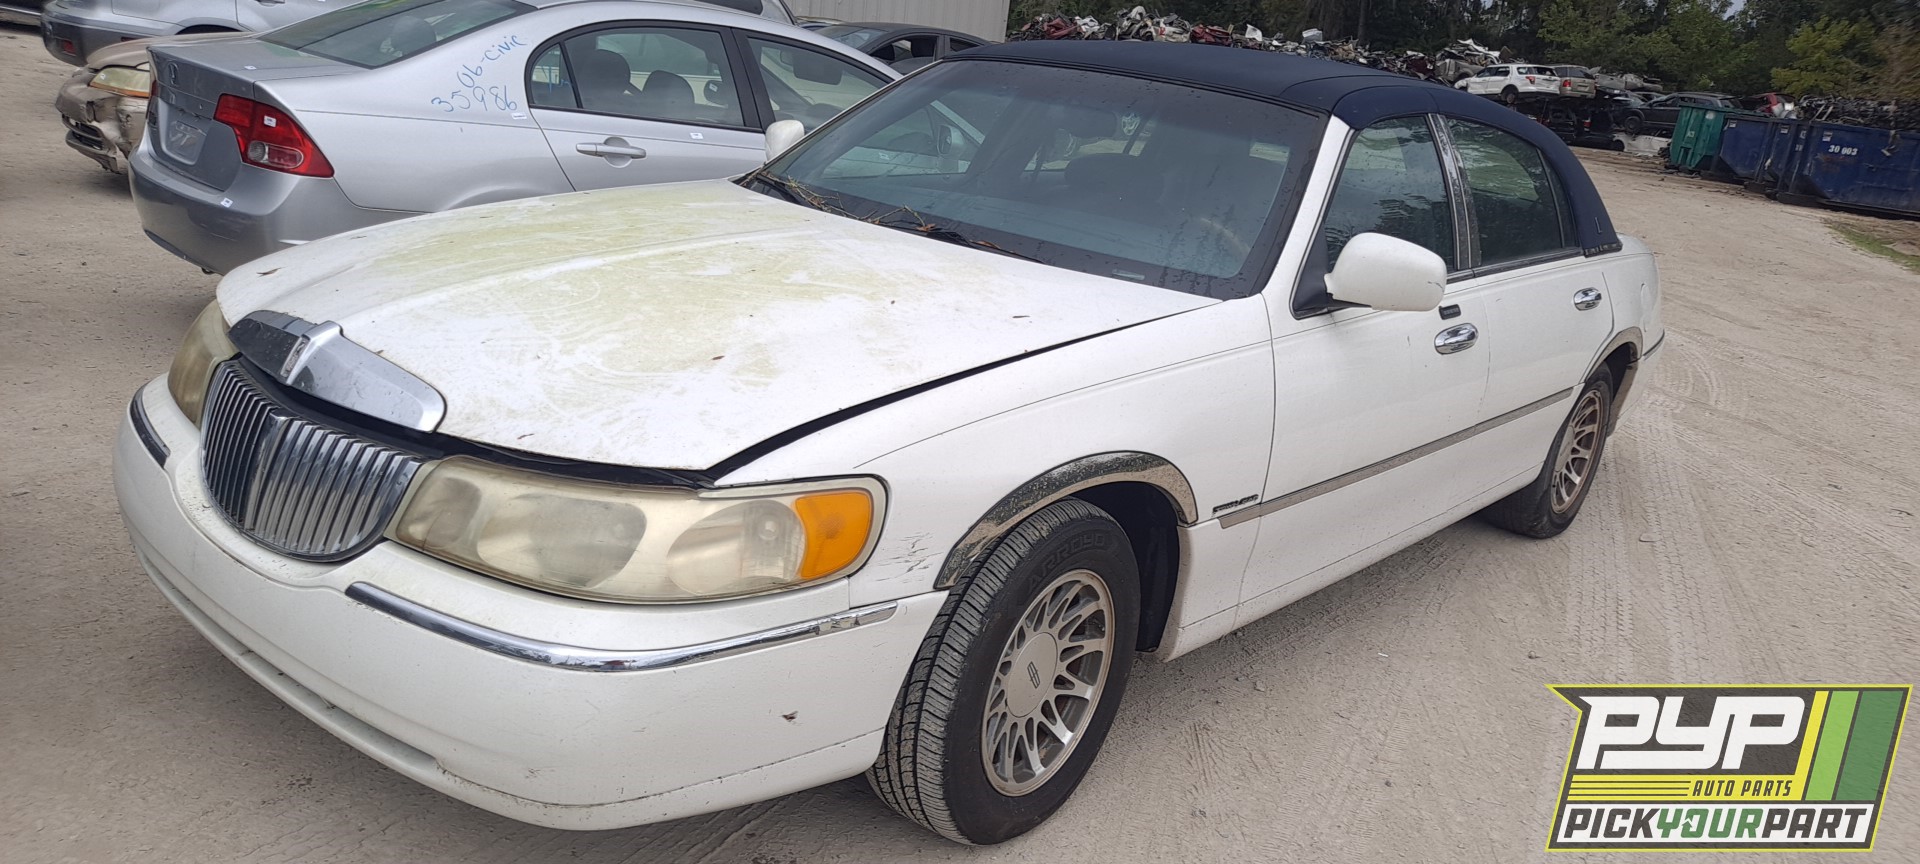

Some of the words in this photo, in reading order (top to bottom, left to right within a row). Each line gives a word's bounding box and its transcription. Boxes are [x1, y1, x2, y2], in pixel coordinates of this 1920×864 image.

[431, 85, 517, 112] 35986
[1828, 145, 1840, 153] 30
[1841, 147, 1858, 156] 003
